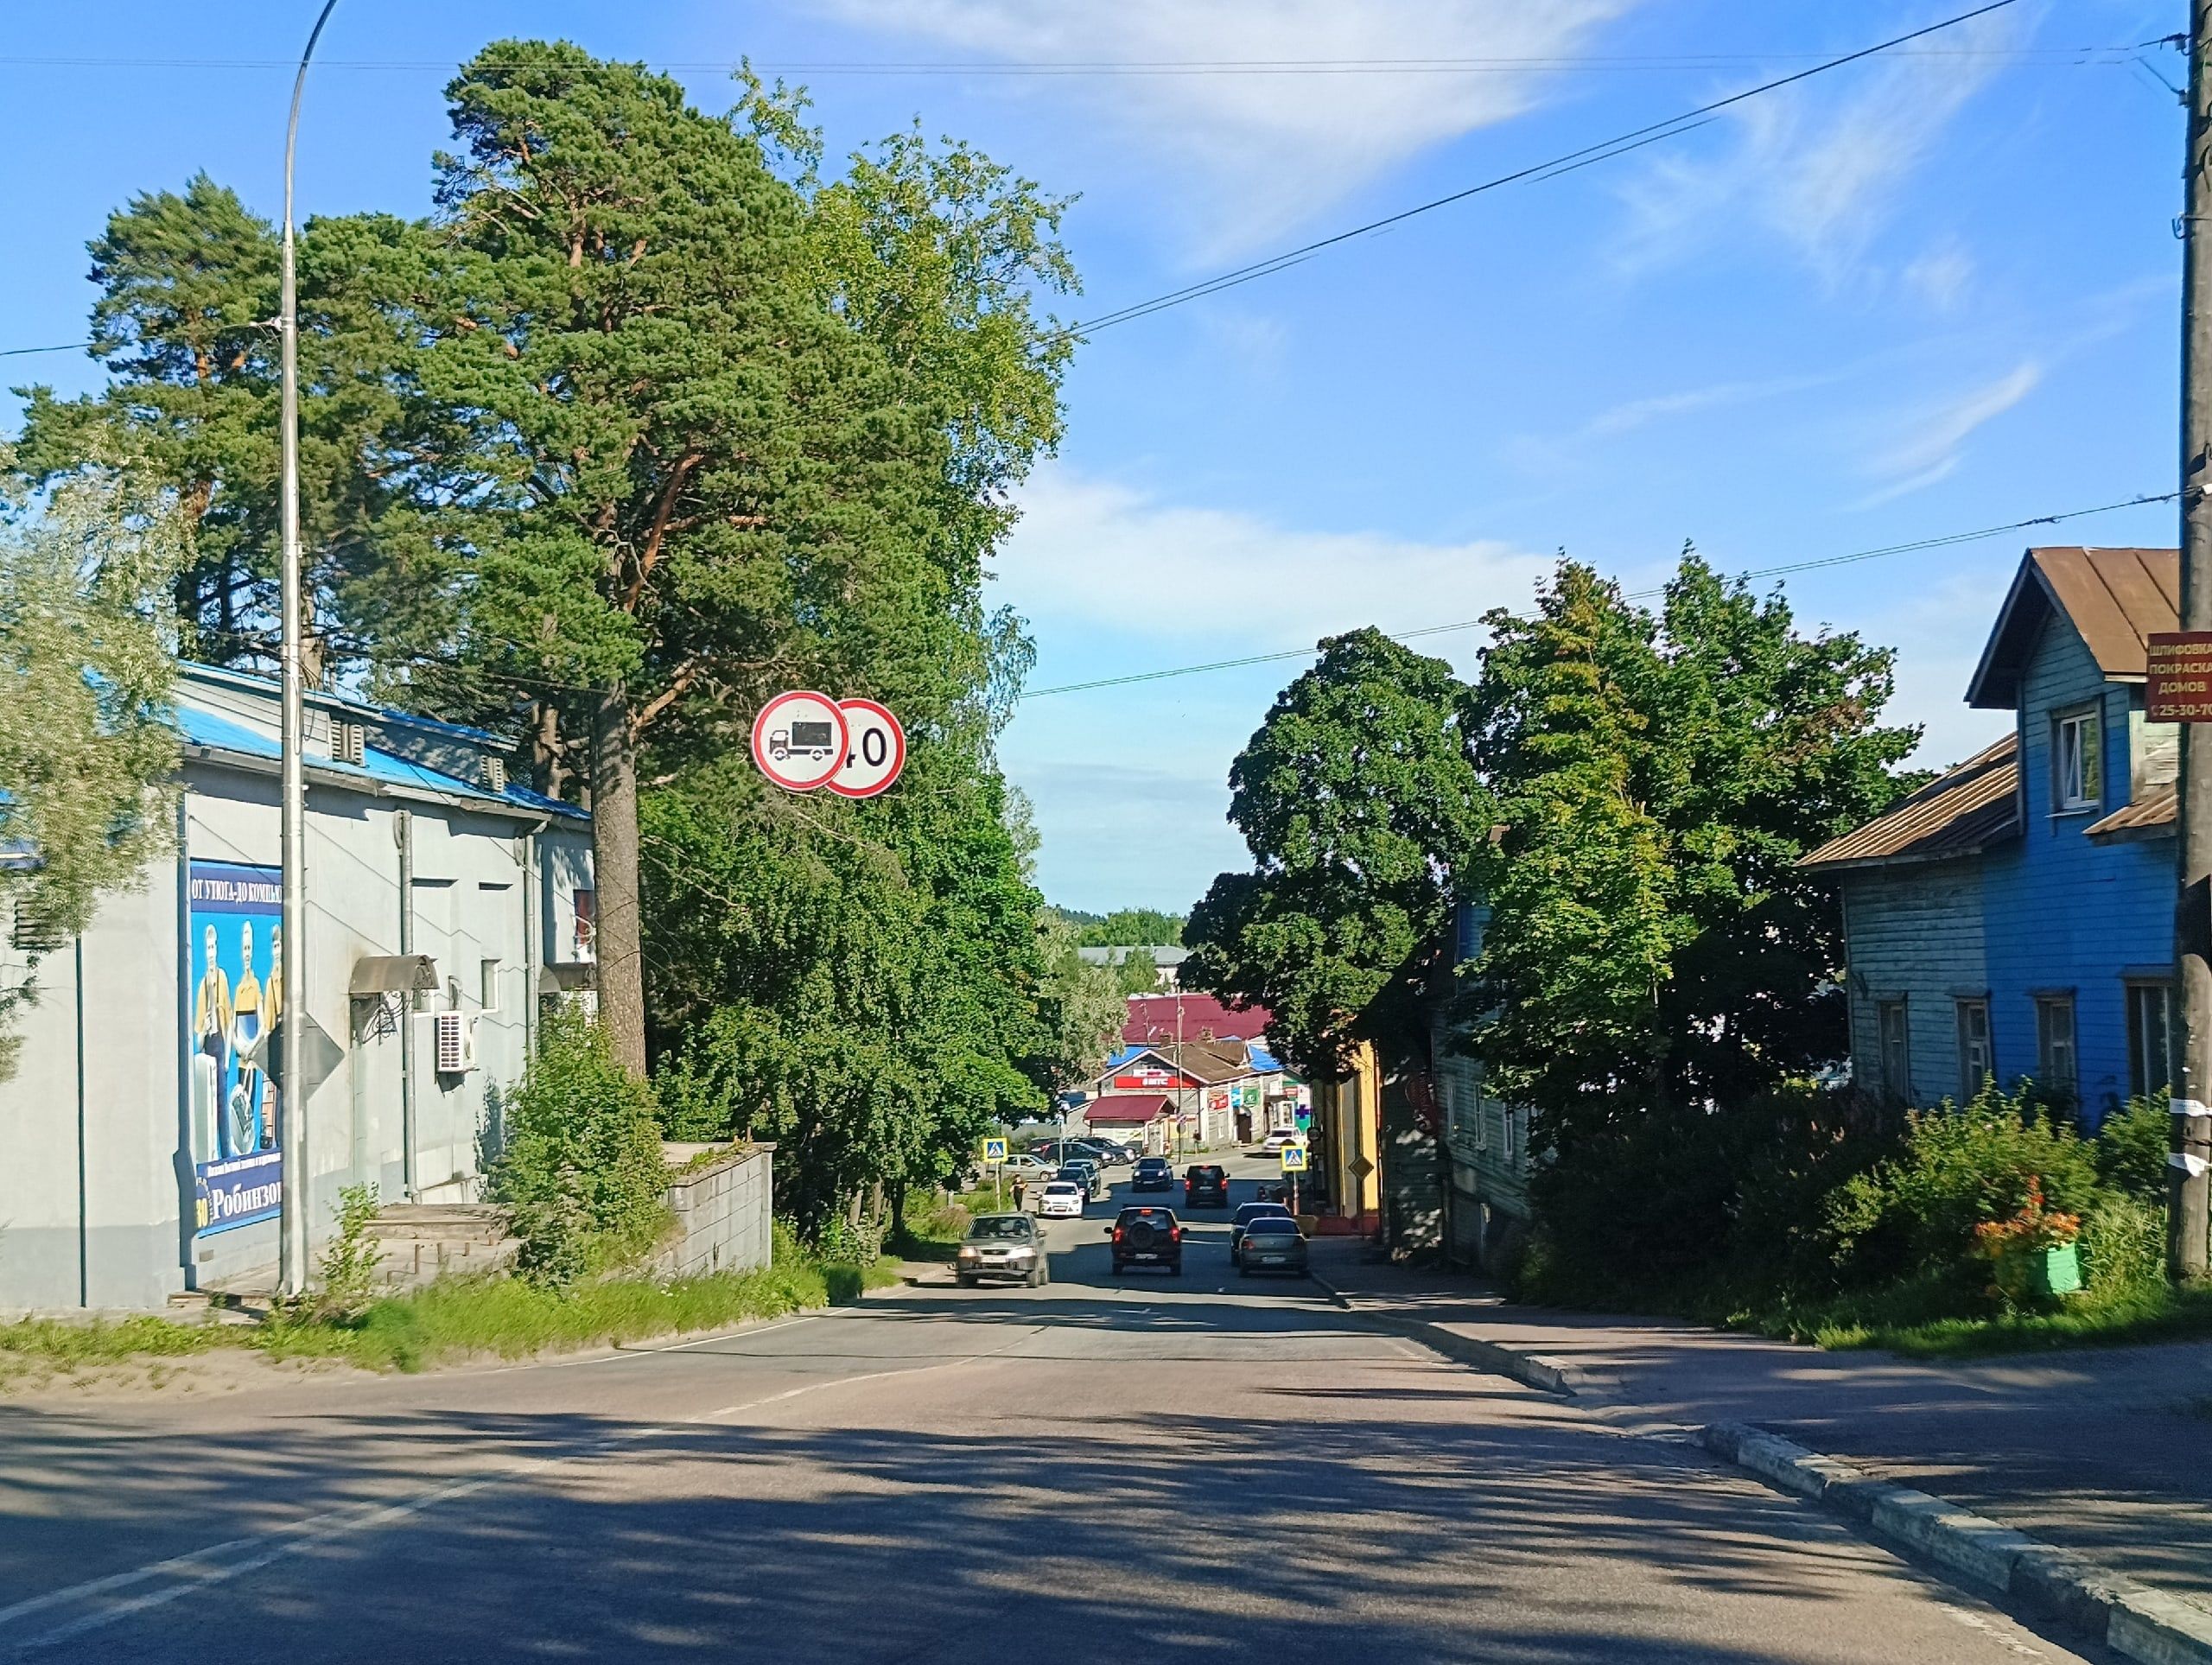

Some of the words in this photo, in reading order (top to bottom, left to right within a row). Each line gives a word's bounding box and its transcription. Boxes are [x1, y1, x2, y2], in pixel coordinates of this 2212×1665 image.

[2150, 662, 2212, 675] ПОКРАСКА
[2158, 681, 2207, 696] ДОМОВ
[192, 879, 204, 899] ОТ
